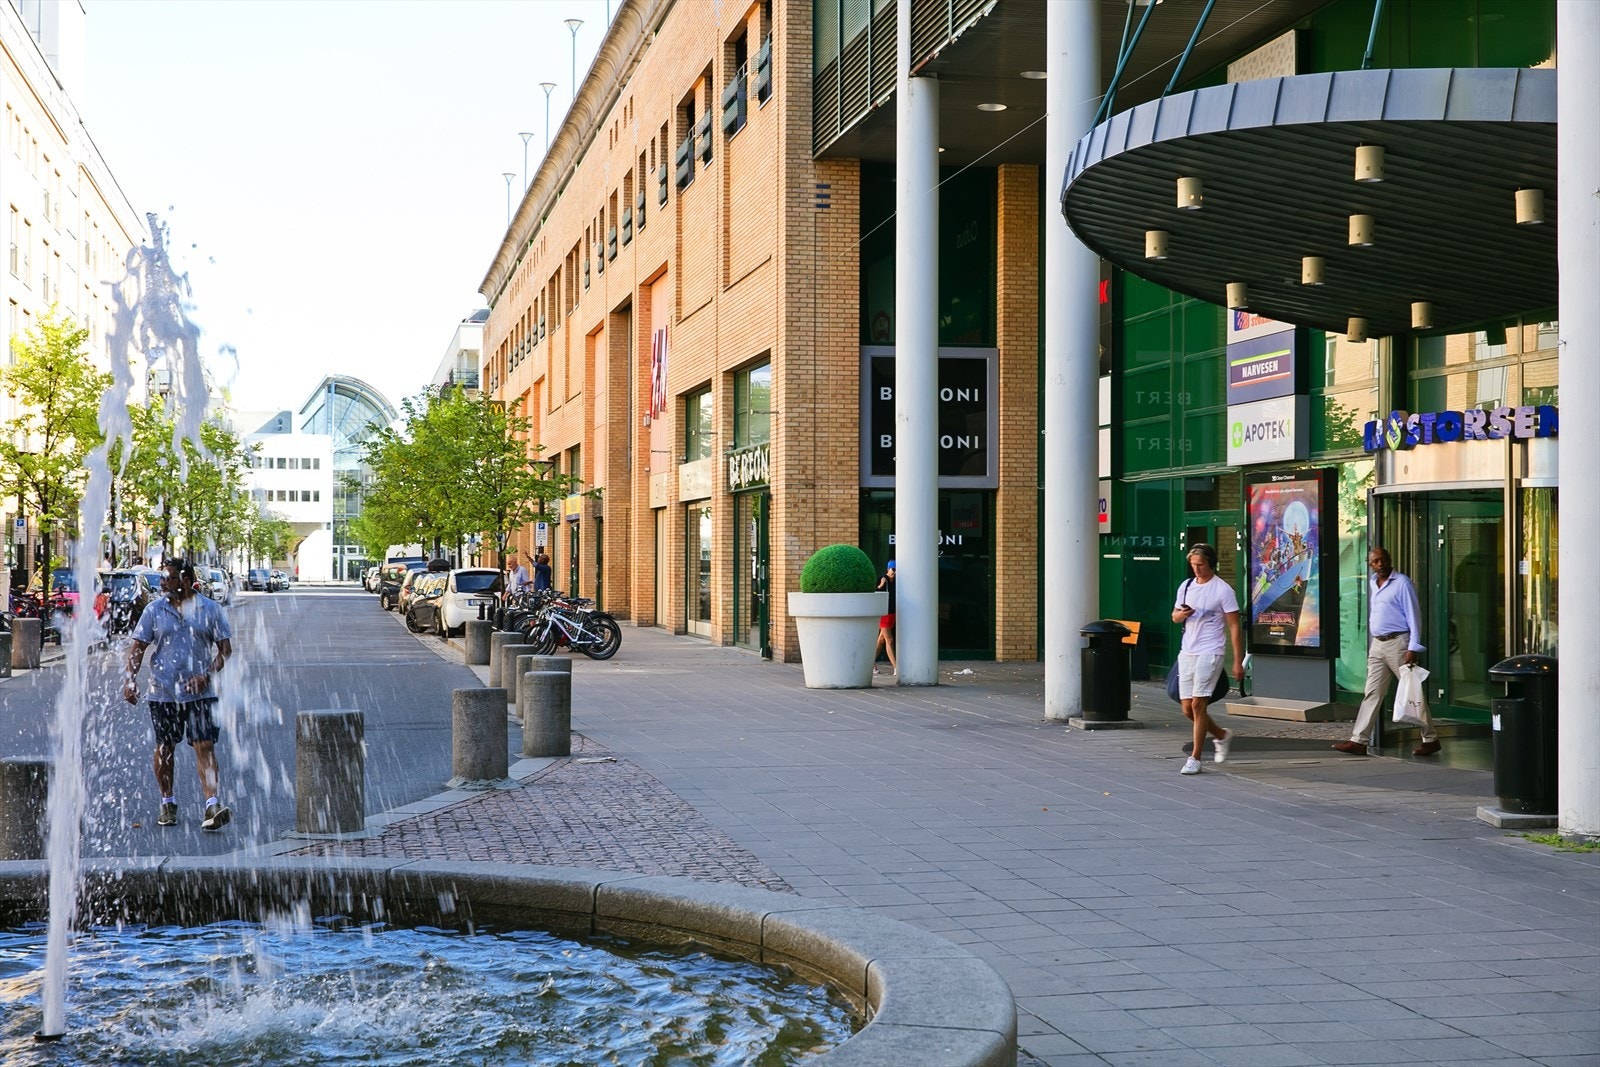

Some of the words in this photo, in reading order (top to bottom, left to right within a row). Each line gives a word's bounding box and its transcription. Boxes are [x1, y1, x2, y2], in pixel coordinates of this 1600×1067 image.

[1242, 360, 1279, 378] NARVESEN
[880, 387, 979, 402] BONI
[1244, 419, 1285, 442] APOTEK
[880, 434, 979, 449] BONI
